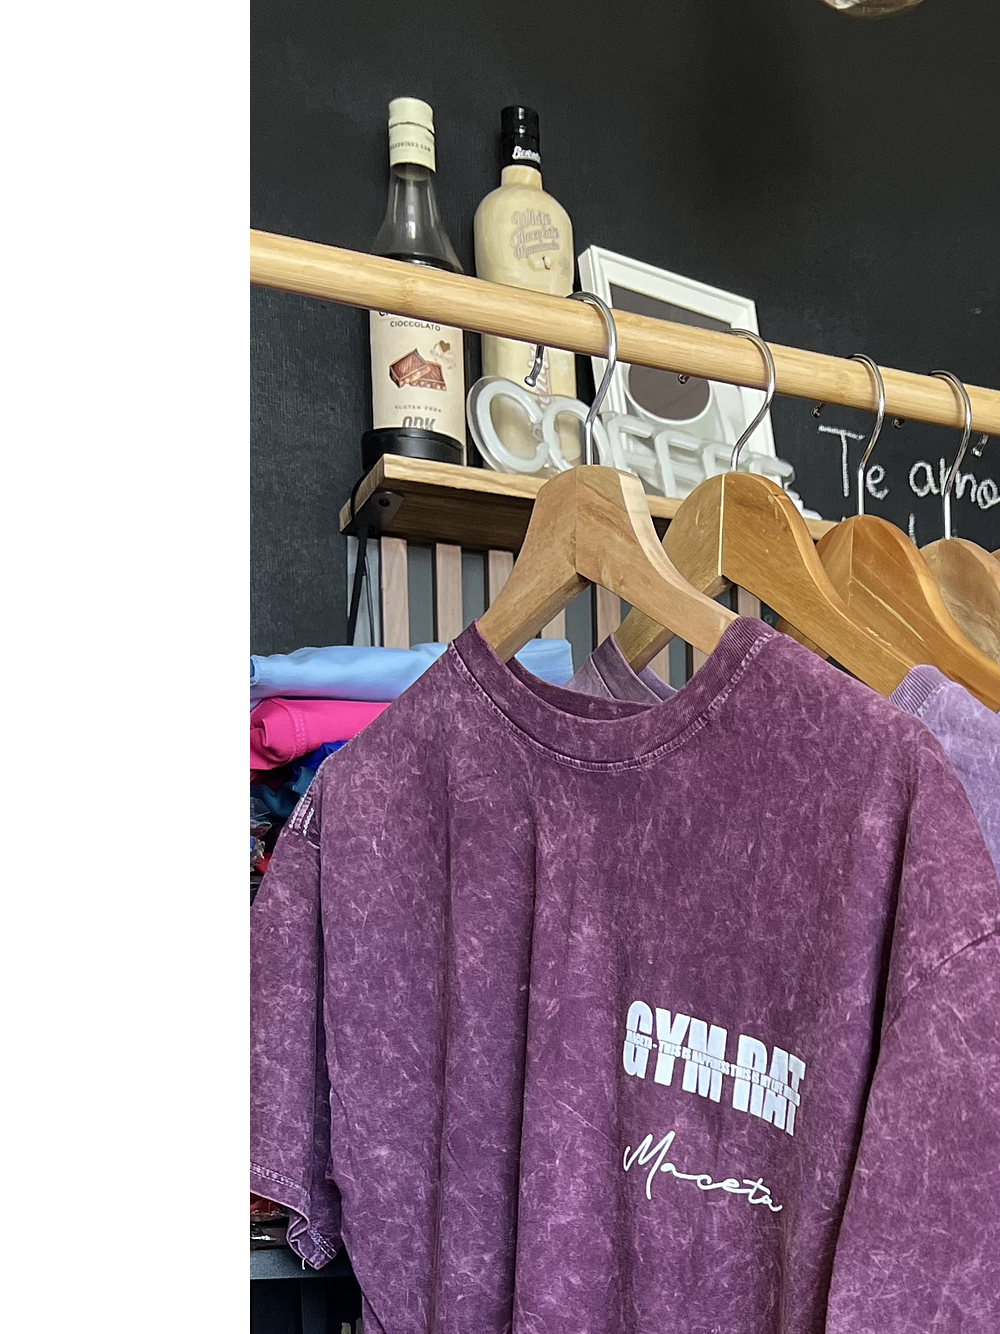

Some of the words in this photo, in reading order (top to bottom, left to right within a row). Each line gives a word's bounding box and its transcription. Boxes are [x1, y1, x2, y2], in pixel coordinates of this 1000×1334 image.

[390, 320, 441, 331] CIOCCOLATO
[817, 425, 889, 499] Te
[622, 1000, 728, 1104] GYM
[732, 1033, 807, 1137] RAT
[623, 1131, 783, 1212] Maceta
